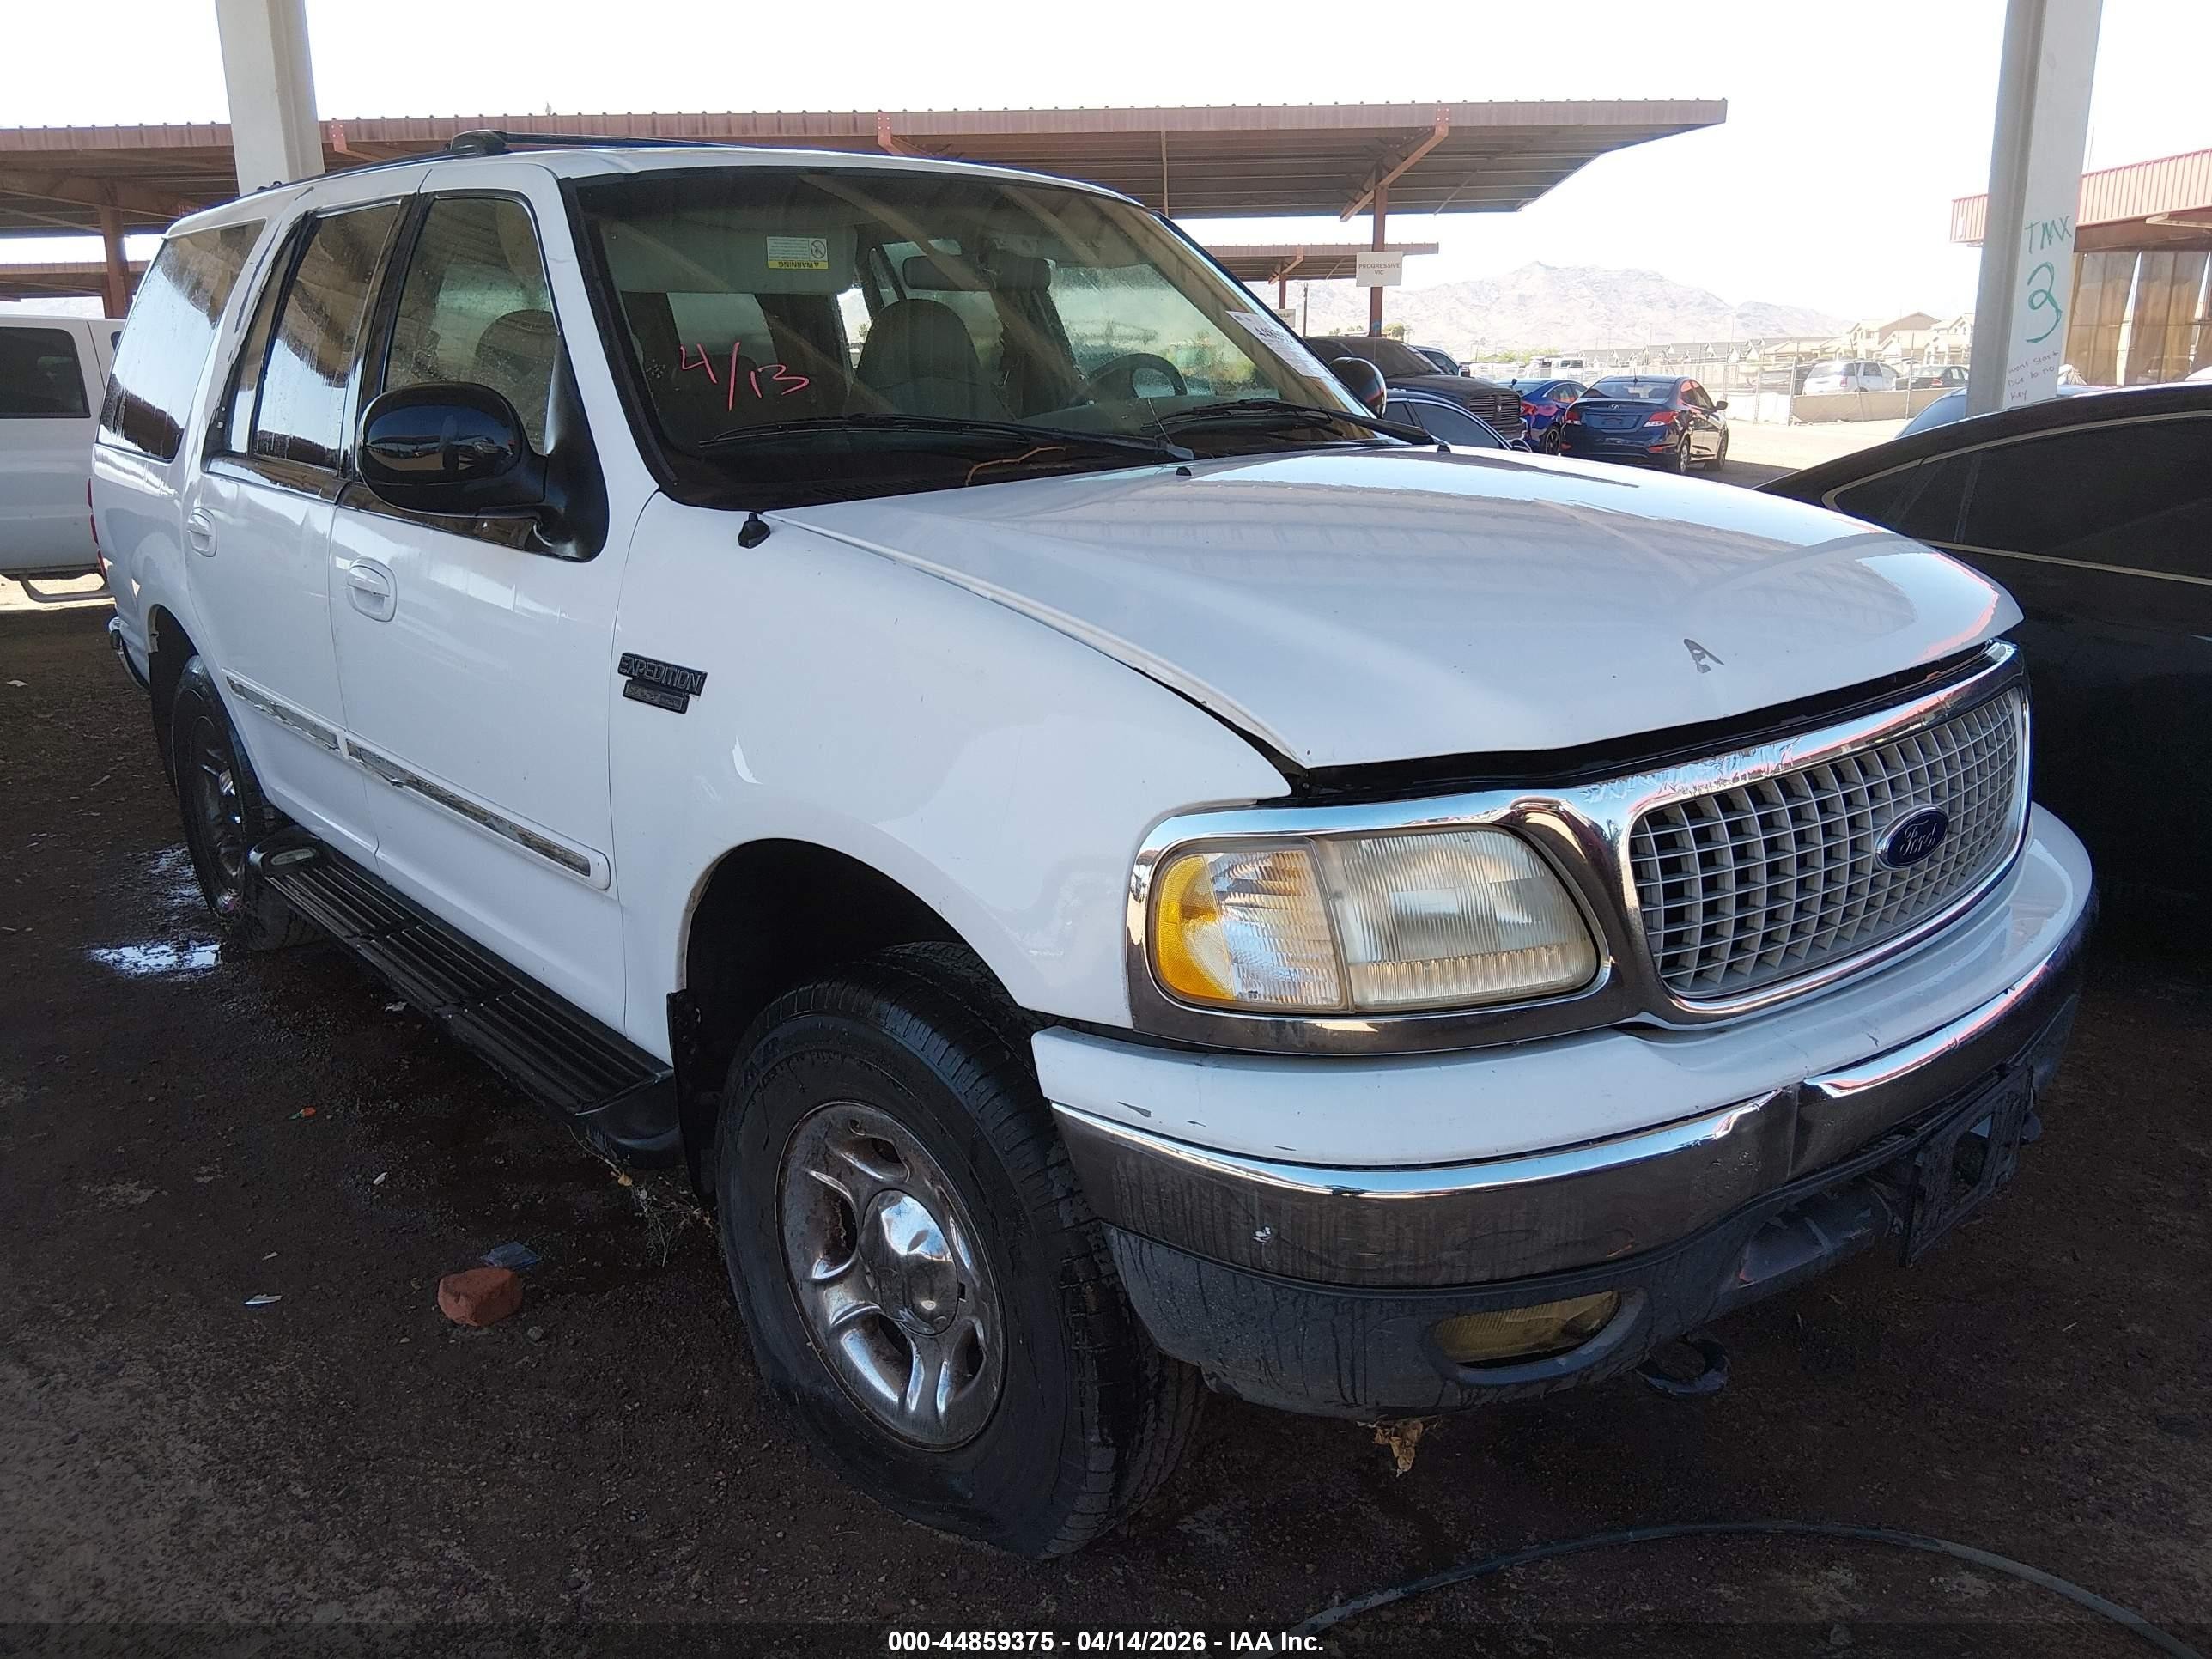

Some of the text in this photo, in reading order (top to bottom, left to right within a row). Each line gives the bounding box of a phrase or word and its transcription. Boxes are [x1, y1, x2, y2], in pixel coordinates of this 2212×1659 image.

[2024, 215, 2073, 254] TMX
[679, 341, 810, 411] 4/13
[618, 653, 702, 692] EXPEDITION
[1899, 818, 1938, 857] Ford
